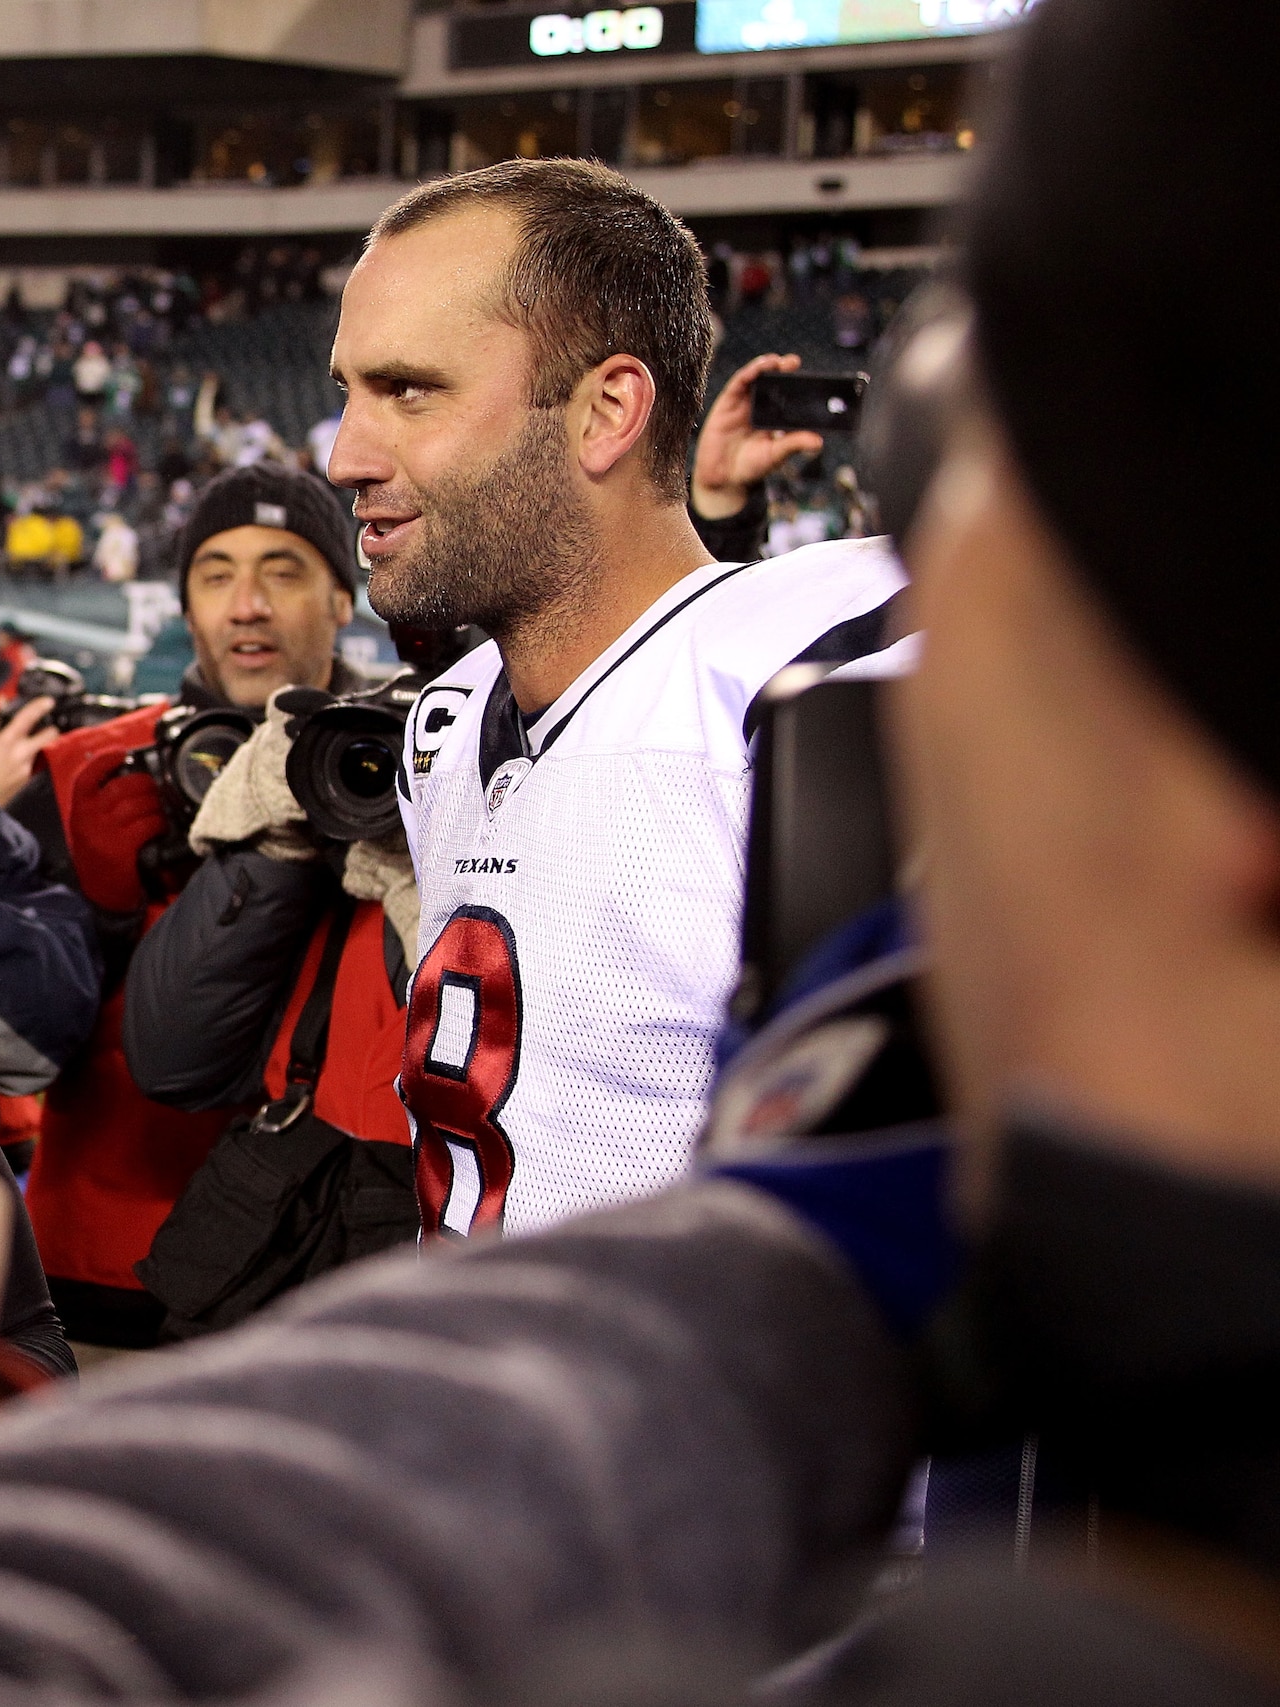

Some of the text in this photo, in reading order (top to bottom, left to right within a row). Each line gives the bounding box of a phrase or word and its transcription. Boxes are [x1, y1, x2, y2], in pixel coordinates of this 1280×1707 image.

[530, 8, 662, 56] 0:00
[415, 688, 470, 752] C
[454, 857, 519, 875] TEXANS
[398, 903, 523, 1246] 8
